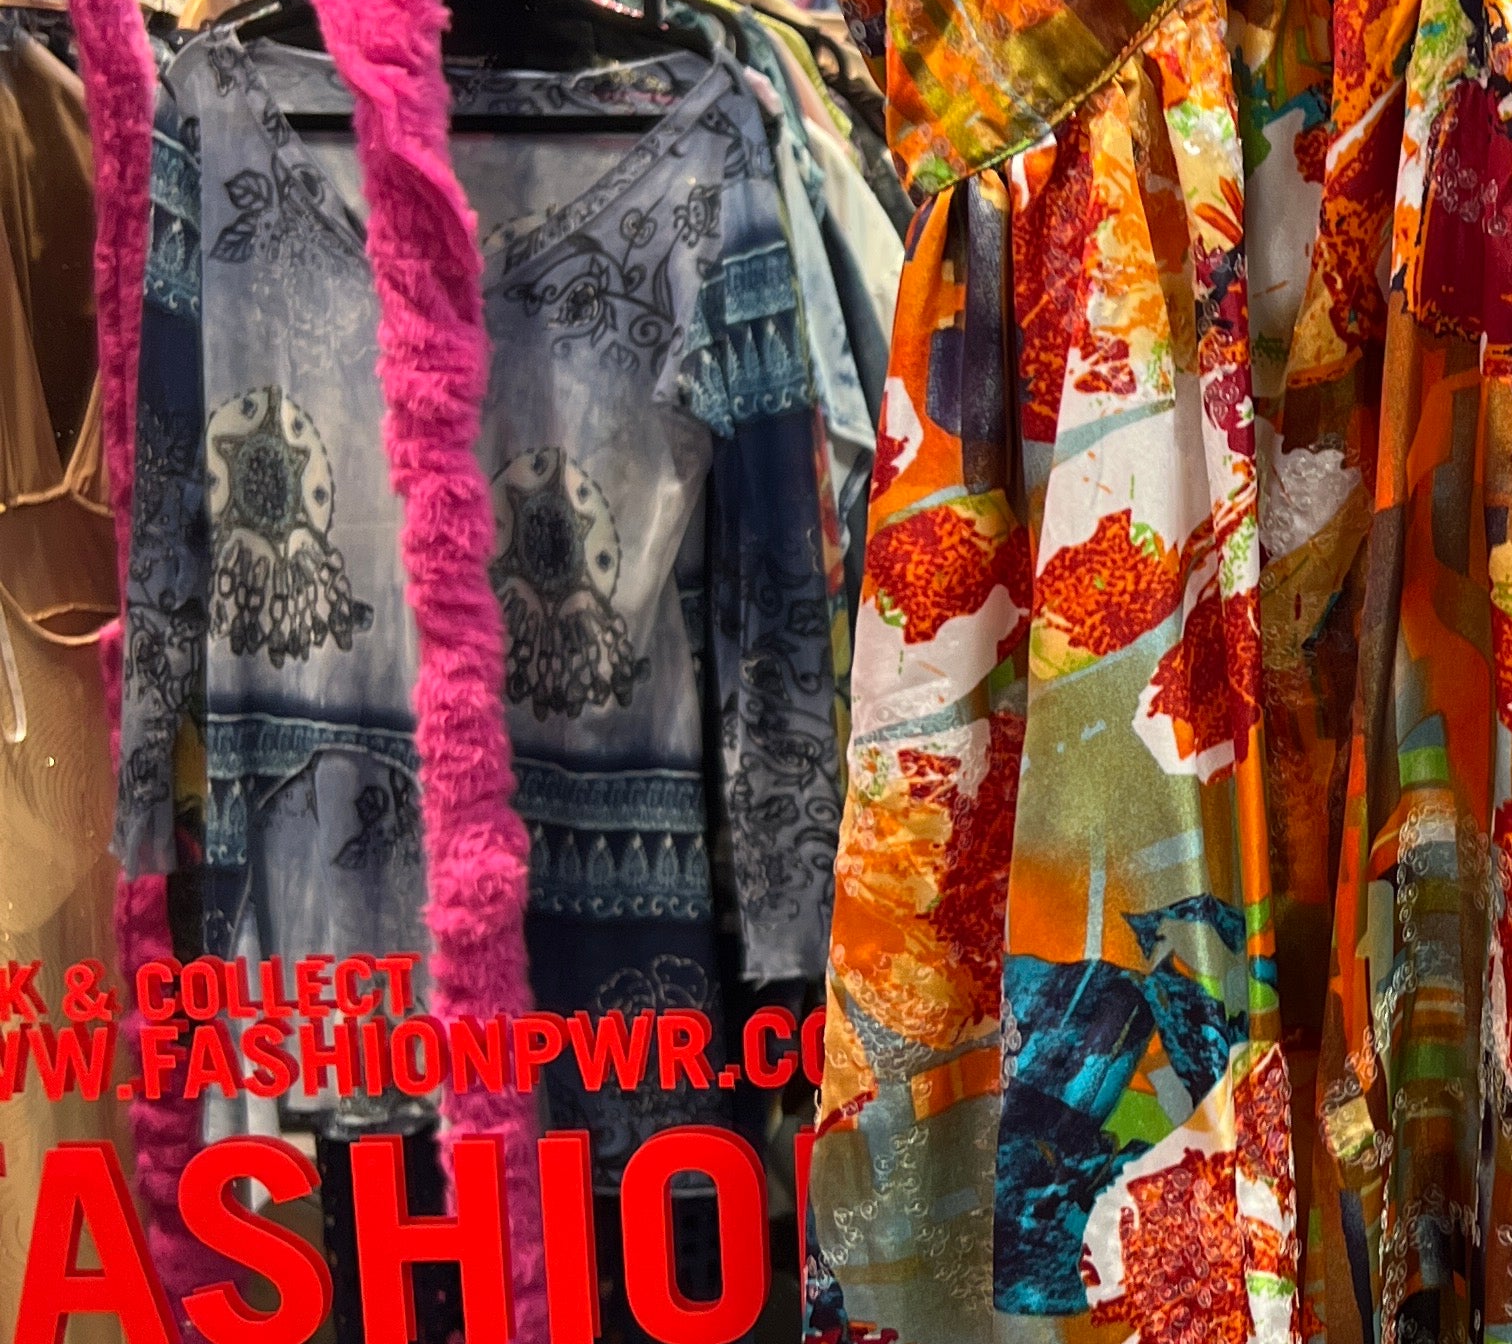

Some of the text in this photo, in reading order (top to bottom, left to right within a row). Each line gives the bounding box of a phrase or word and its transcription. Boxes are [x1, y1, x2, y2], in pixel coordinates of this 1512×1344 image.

[63, 964, 113, 1022] &
[136, 957, 414, 1021] COLLECT
[0, 1011, 828, 1102] W.FASHIONPWR.C
